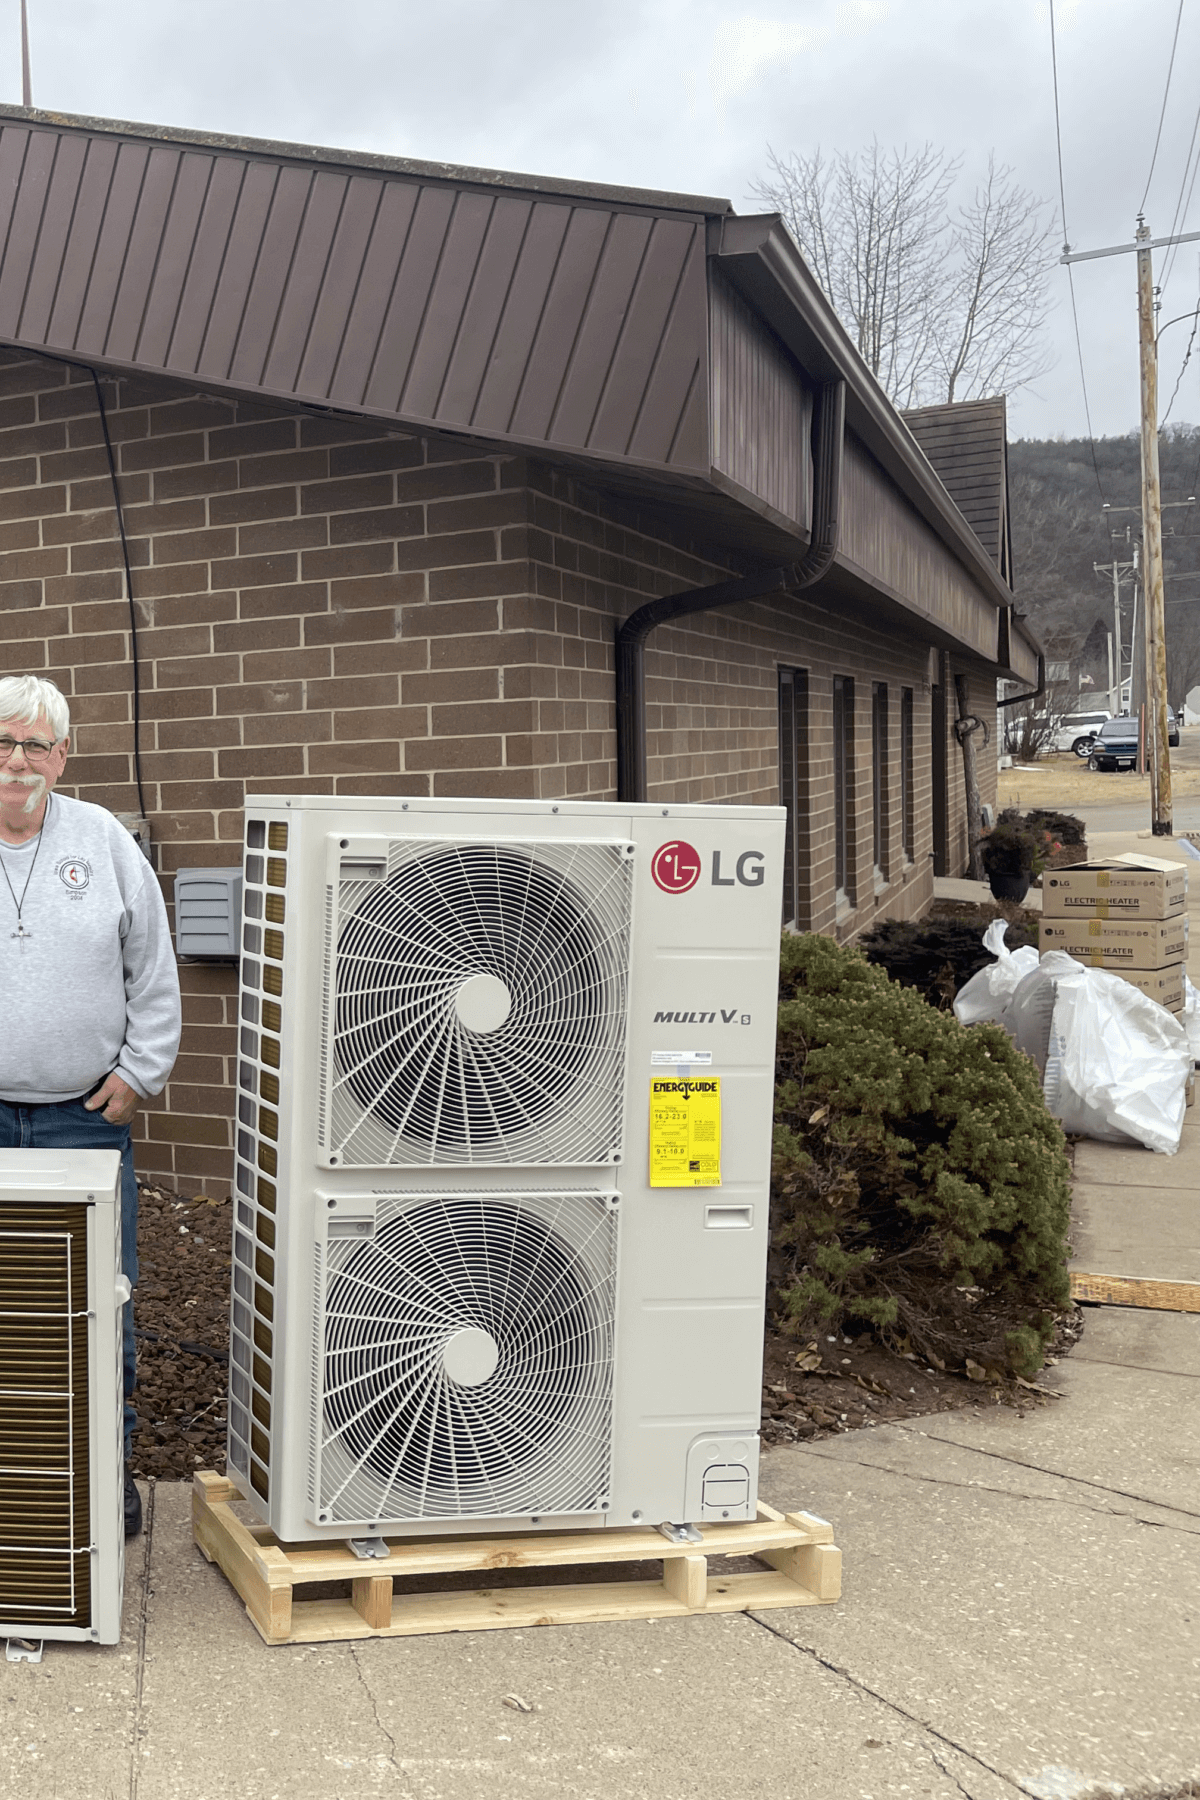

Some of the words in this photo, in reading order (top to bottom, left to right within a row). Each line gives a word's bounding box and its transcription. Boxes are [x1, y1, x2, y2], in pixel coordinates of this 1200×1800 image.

[711, 850, 765, 887] LG
[1101, 947, 1133, 955] HEATER
[653, 1011, 716, 1023] MULTI
[741, 1014, 751, 1025] S
[653, 1082, 718, 1093] ENERGYGUIDE
